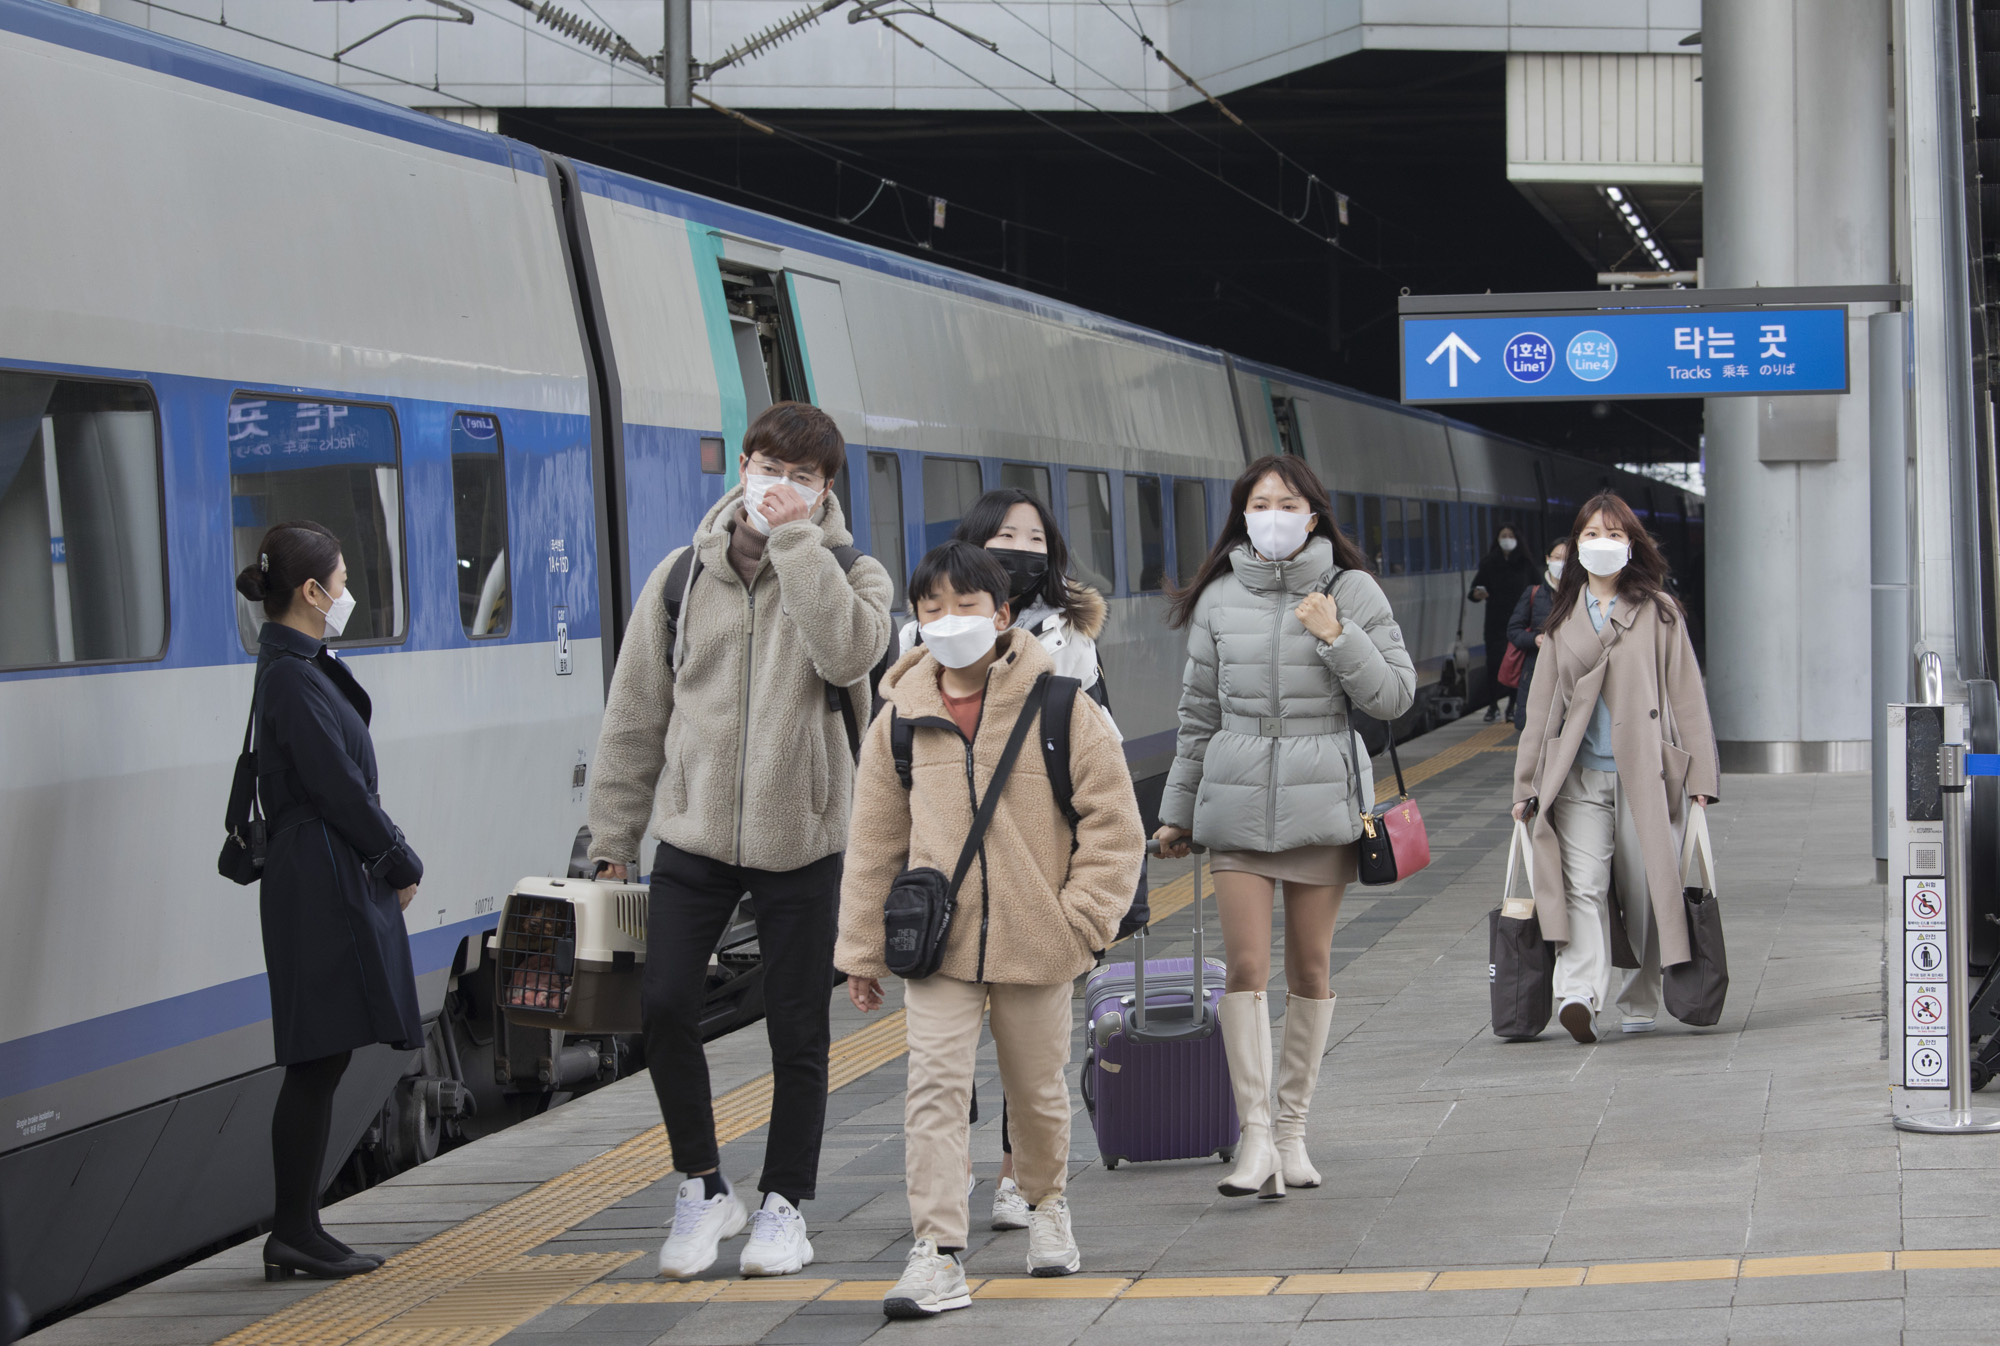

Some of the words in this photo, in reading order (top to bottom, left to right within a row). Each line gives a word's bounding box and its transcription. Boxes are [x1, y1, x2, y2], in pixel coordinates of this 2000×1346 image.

[1572, 341, 1610, 358] 4호선
[1675, 326, 1735, 359] 타는
[1759, 325, 1787, 358] 곳
[1510, 343, 1547, 359] 1호선
[1667, 365, 1712, 379] Tracks
[1759, 363, 1796, 376] のりば
[558, 627, 567, 654] 12
